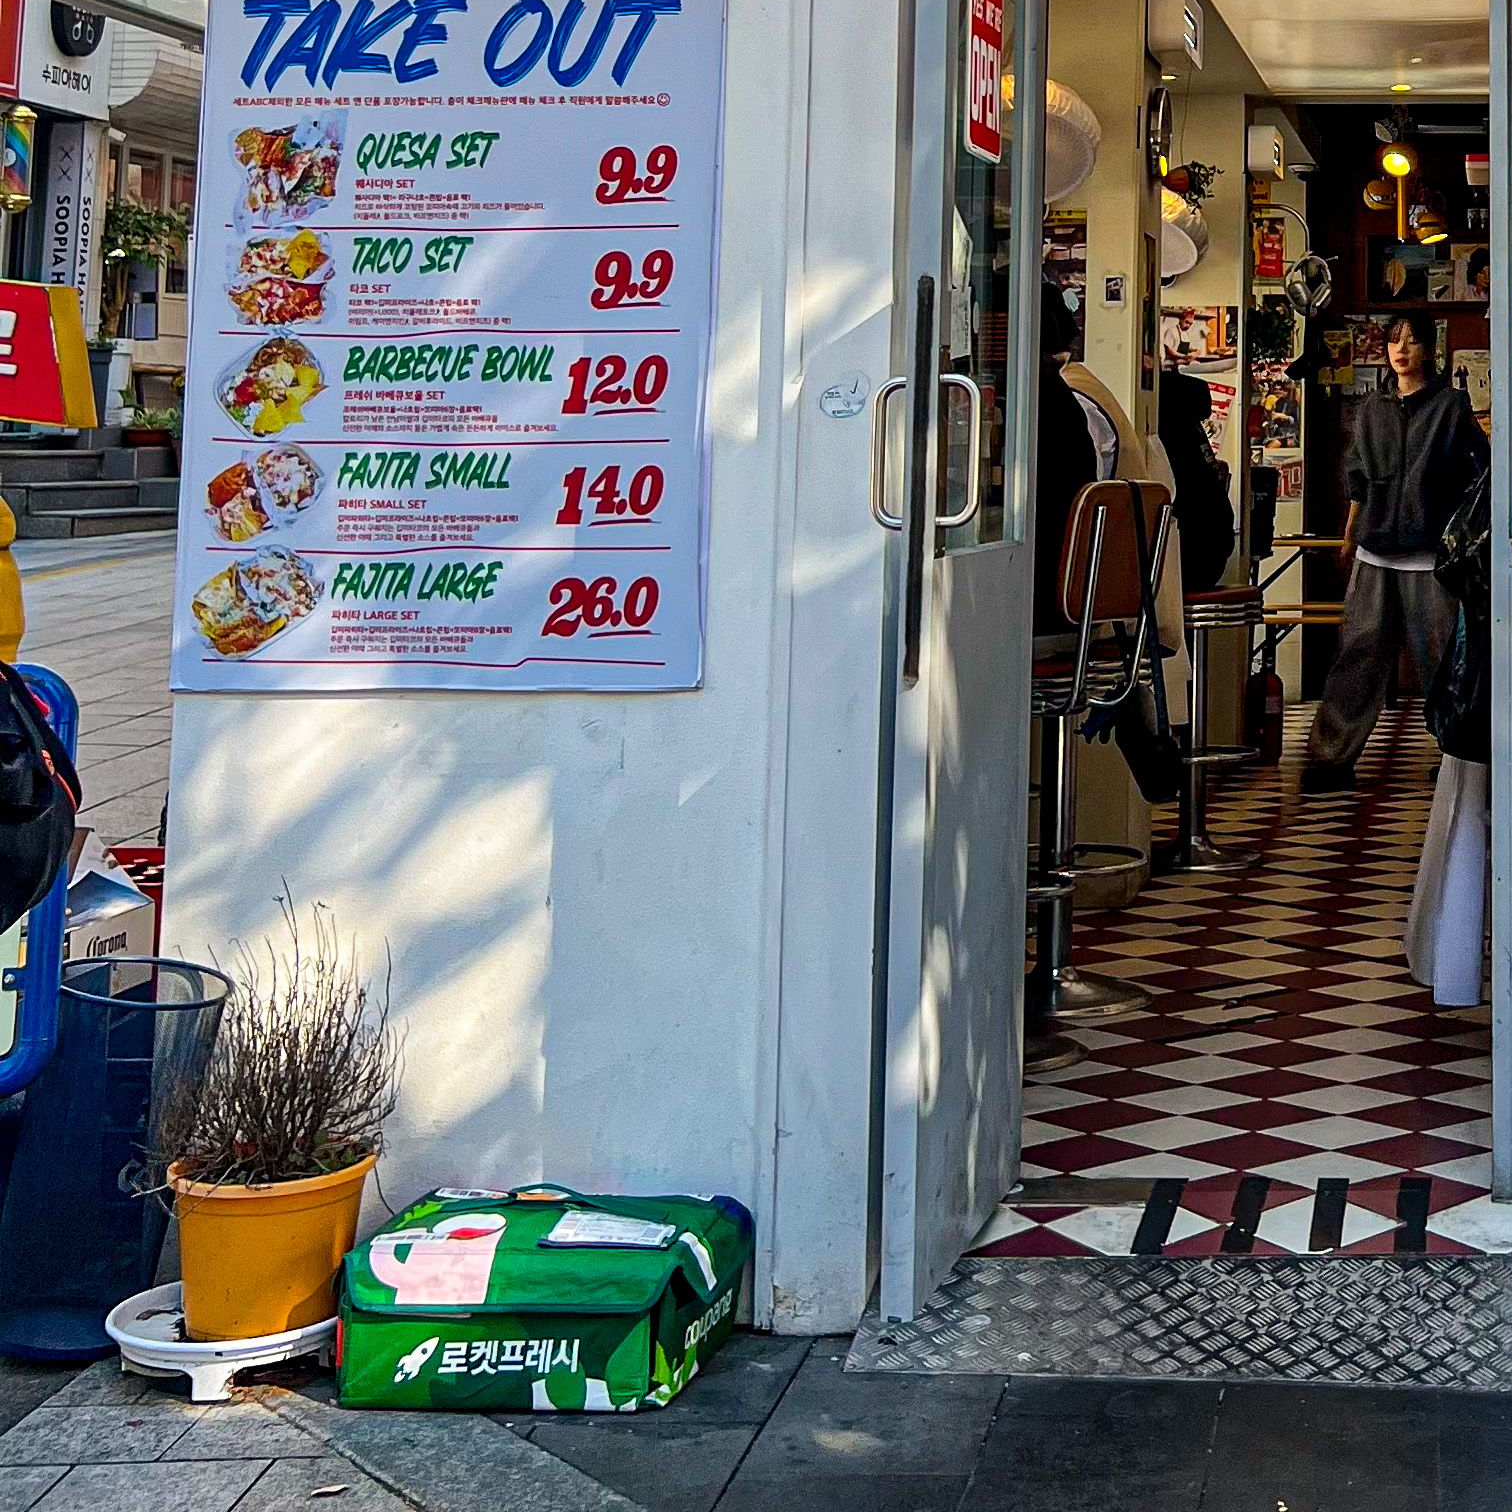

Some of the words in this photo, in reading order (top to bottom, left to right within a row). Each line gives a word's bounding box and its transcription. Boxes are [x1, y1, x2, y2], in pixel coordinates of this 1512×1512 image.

[971, 34, 1001, 134] OPEN
[356, 131, 443, 176] QUESA
[445, 131, 501, 170] SET
[595, 144, 678, 204] 9.9
[396, 179, 416, 189] SET
[52, 195, 71, 267] SOOPIA
[79, 196, 92, 267] SOOPIA
[352, 237, 414, 276] TACO
[419, 236, 475, 274] SET
[350, 284, 369, 294] 타코
[371, 284, 392, 294] SET
[590, 249, 675, 310] 9.9
[343, 344, 480, 384] BARBECUE
[481, 344, 555, 383] BOWL
[561, 354, 670, 415] 12.0
[426, 391, 445, 400] SET
[337, 451, 422, 491] FAJITA
[425, 450, 512, 491] SMALL
[370, 500, 405, 509] SMALL
[407, 500, 428, 509] SET
[556, 464, 665, 525] 14.0
[331, 562, 416, 602] FAJITA
[417, 561, 504, 604] LARGE
[364, 610, 398, 620] LARGE
[400, 610, 421, 620] SET
[541, 575, 660, 638] 26.0
[86, 931, 128, 958] Corona
[437, 1338, 582, 1376] 로켓프레시
